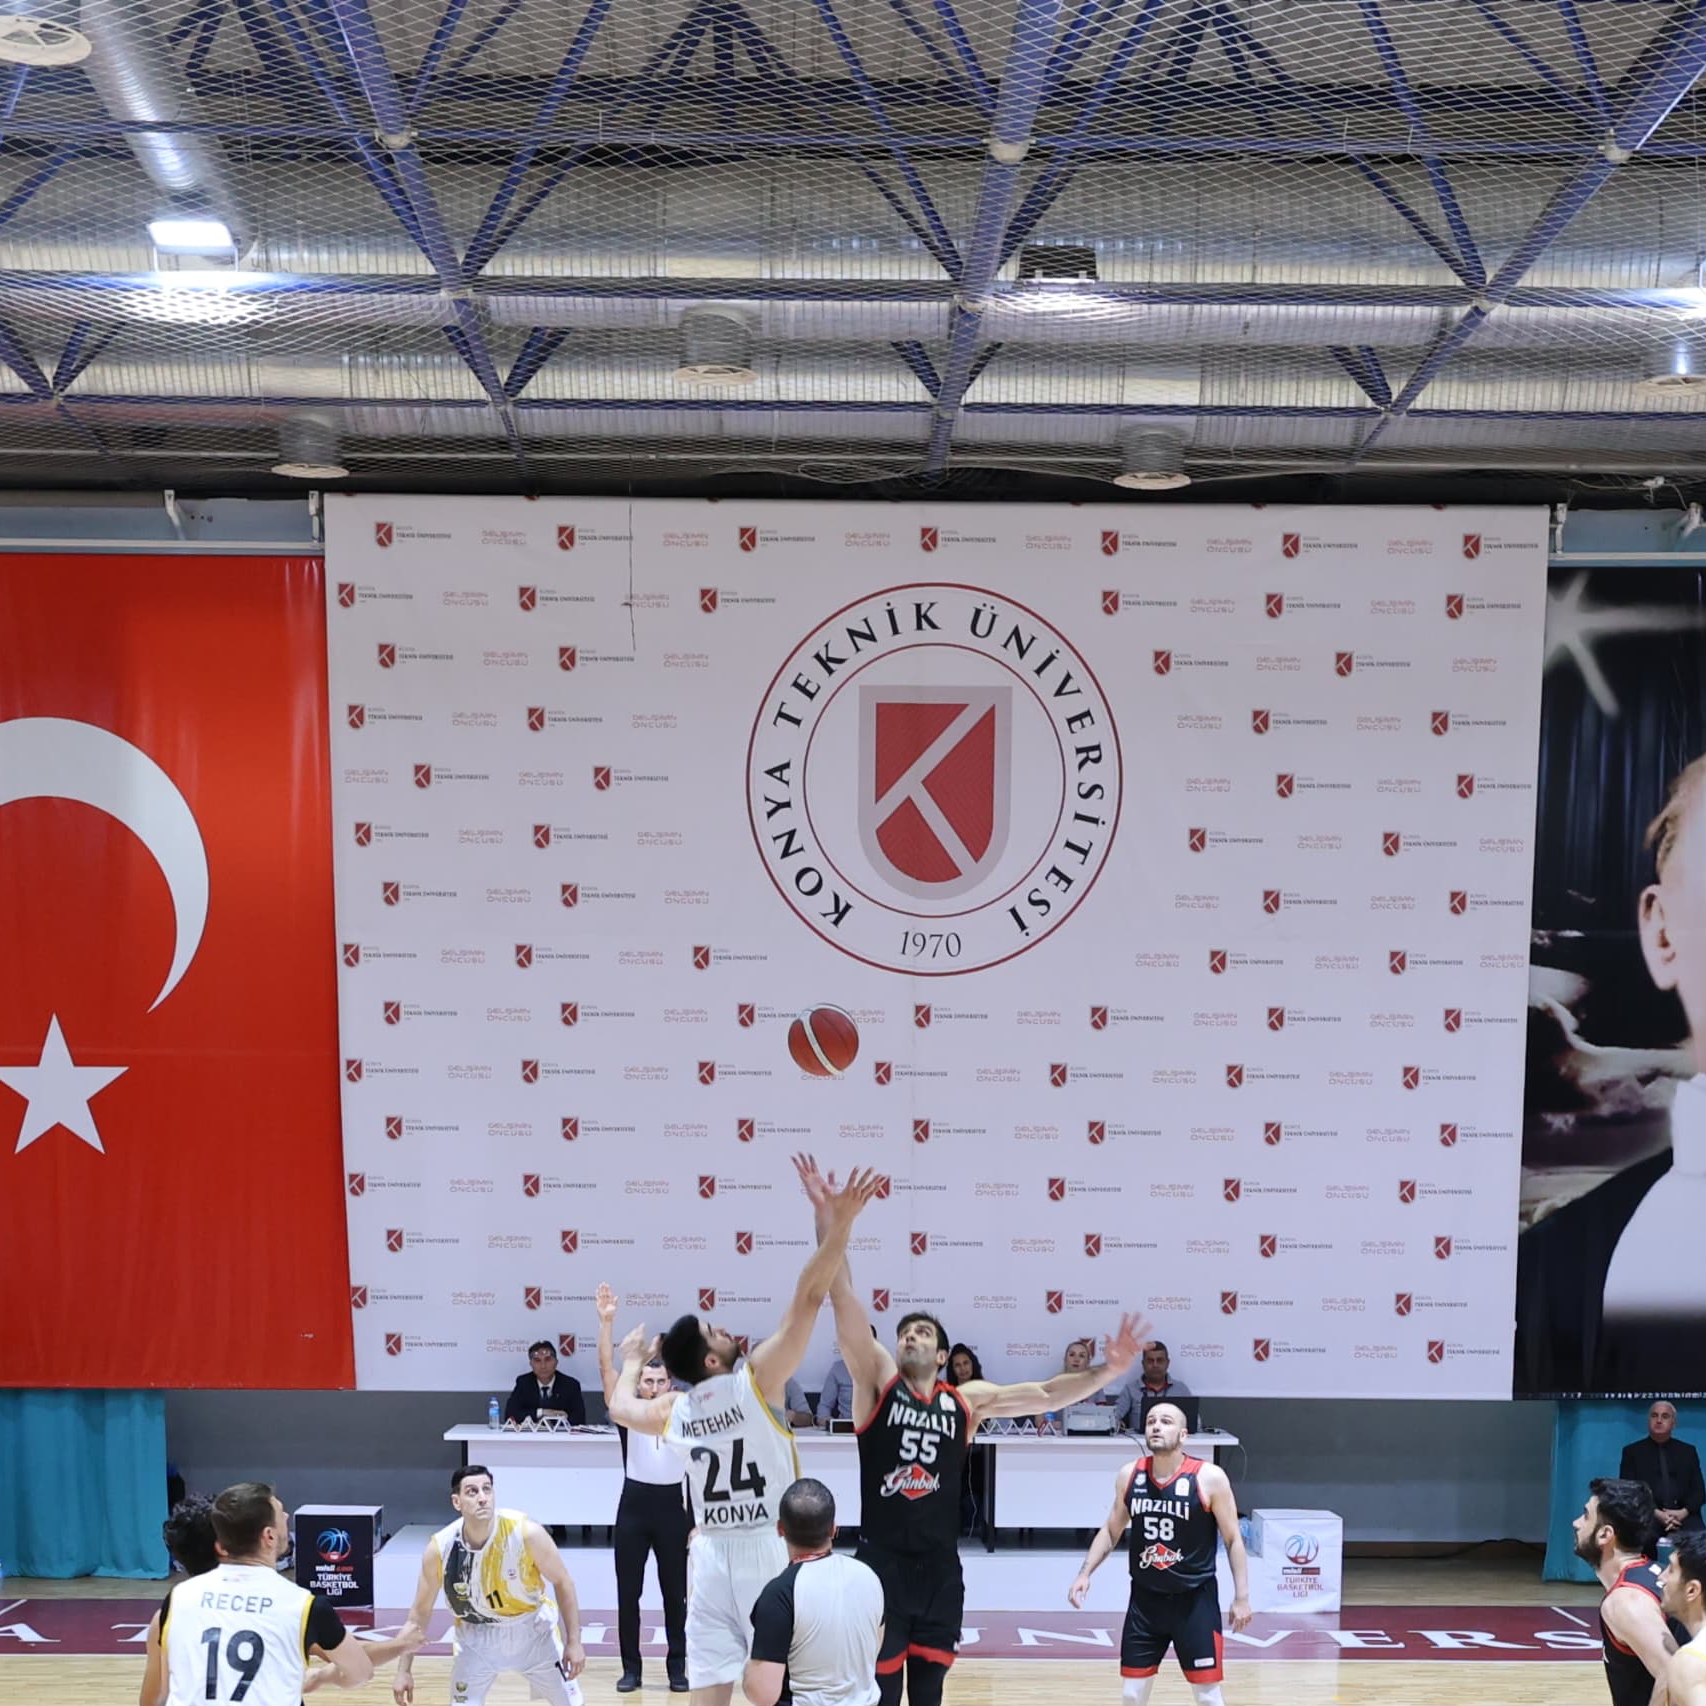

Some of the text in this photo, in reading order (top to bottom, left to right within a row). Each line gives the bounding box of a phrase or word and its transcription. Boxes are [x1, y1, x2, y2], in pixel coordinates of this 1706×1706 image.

[763, 601, 1106, 937] KONYA TEKNİK ÜNİVERSİTESİ
[899, 930, 962, 959] 1970
[681, 1404, 744, 1439] METEHAN
[899, 1429, 940, 1465] 55
[690, 1438, 767, 1503] 24
[704, 1502, 769, 1526] KONYA
[1143, 1516, 1174, 1541] 58
[309, 1580, 360, 1589] BASKETBOL
[317, 1572, 353, 1581] TÜRKİYE
[200, 1591, 274, 1615] RECEP
[485, 1589, 504, 1610] 11
[201, 1626, 265, 1703] 19
